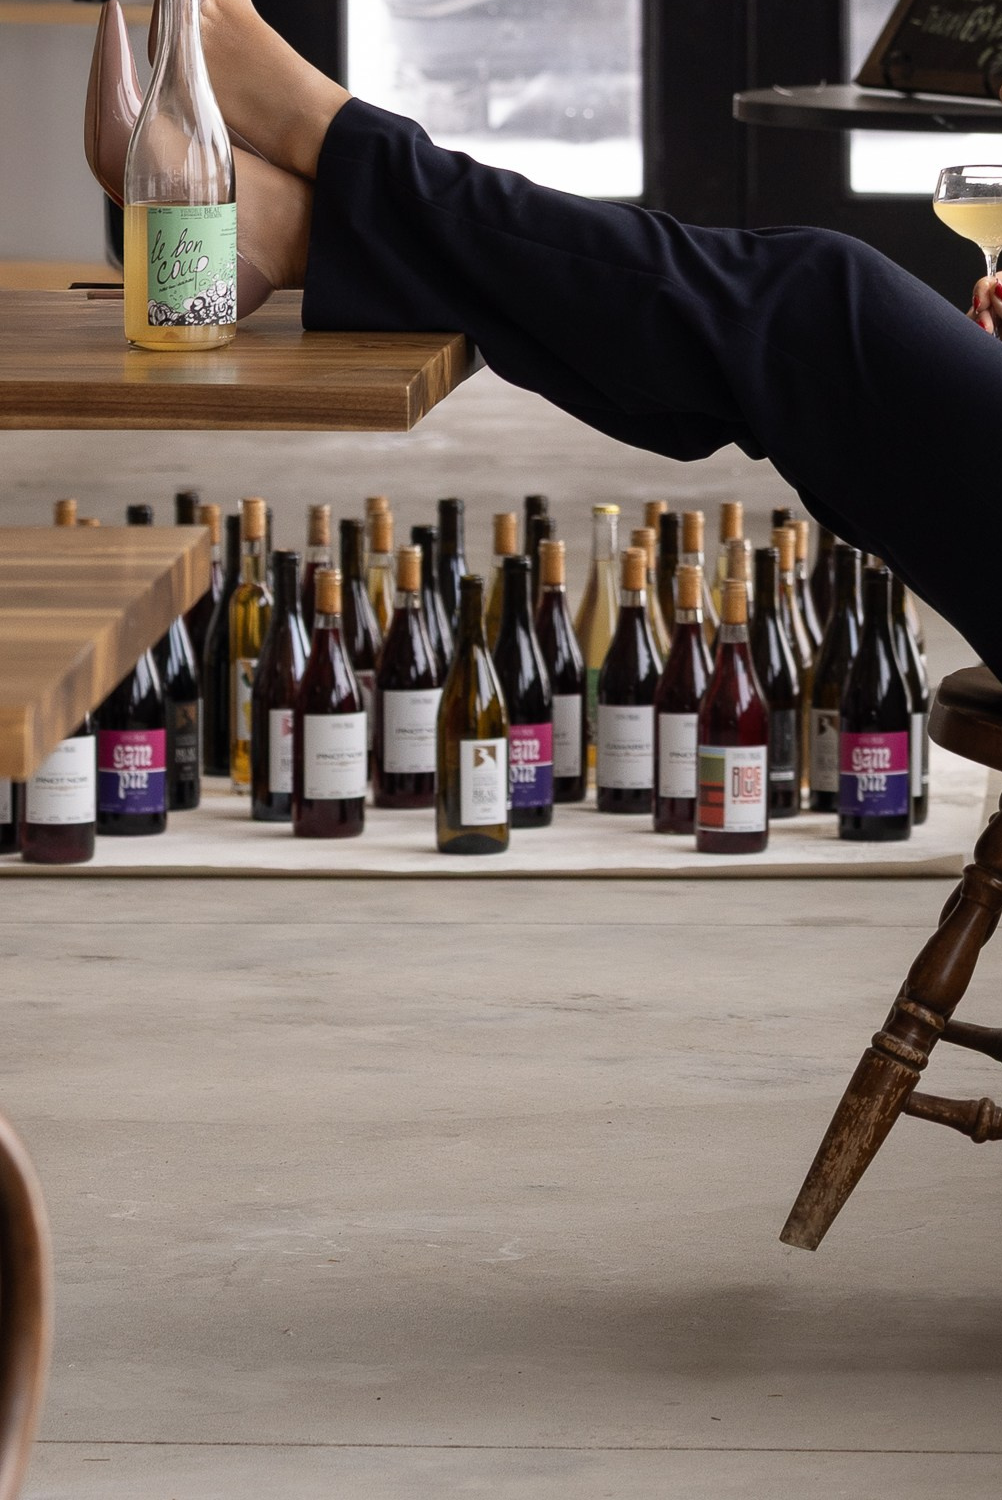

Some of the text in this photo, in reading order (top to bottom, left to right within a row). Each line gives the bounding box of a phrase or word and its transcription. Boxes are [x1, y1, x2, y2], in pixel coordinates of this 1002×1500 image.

[151, 228, 202, 263] le bon
[113, 744, 152, 768] gam
[510, 738, 540, 761] am
[852, 747, 891, 771] gam
